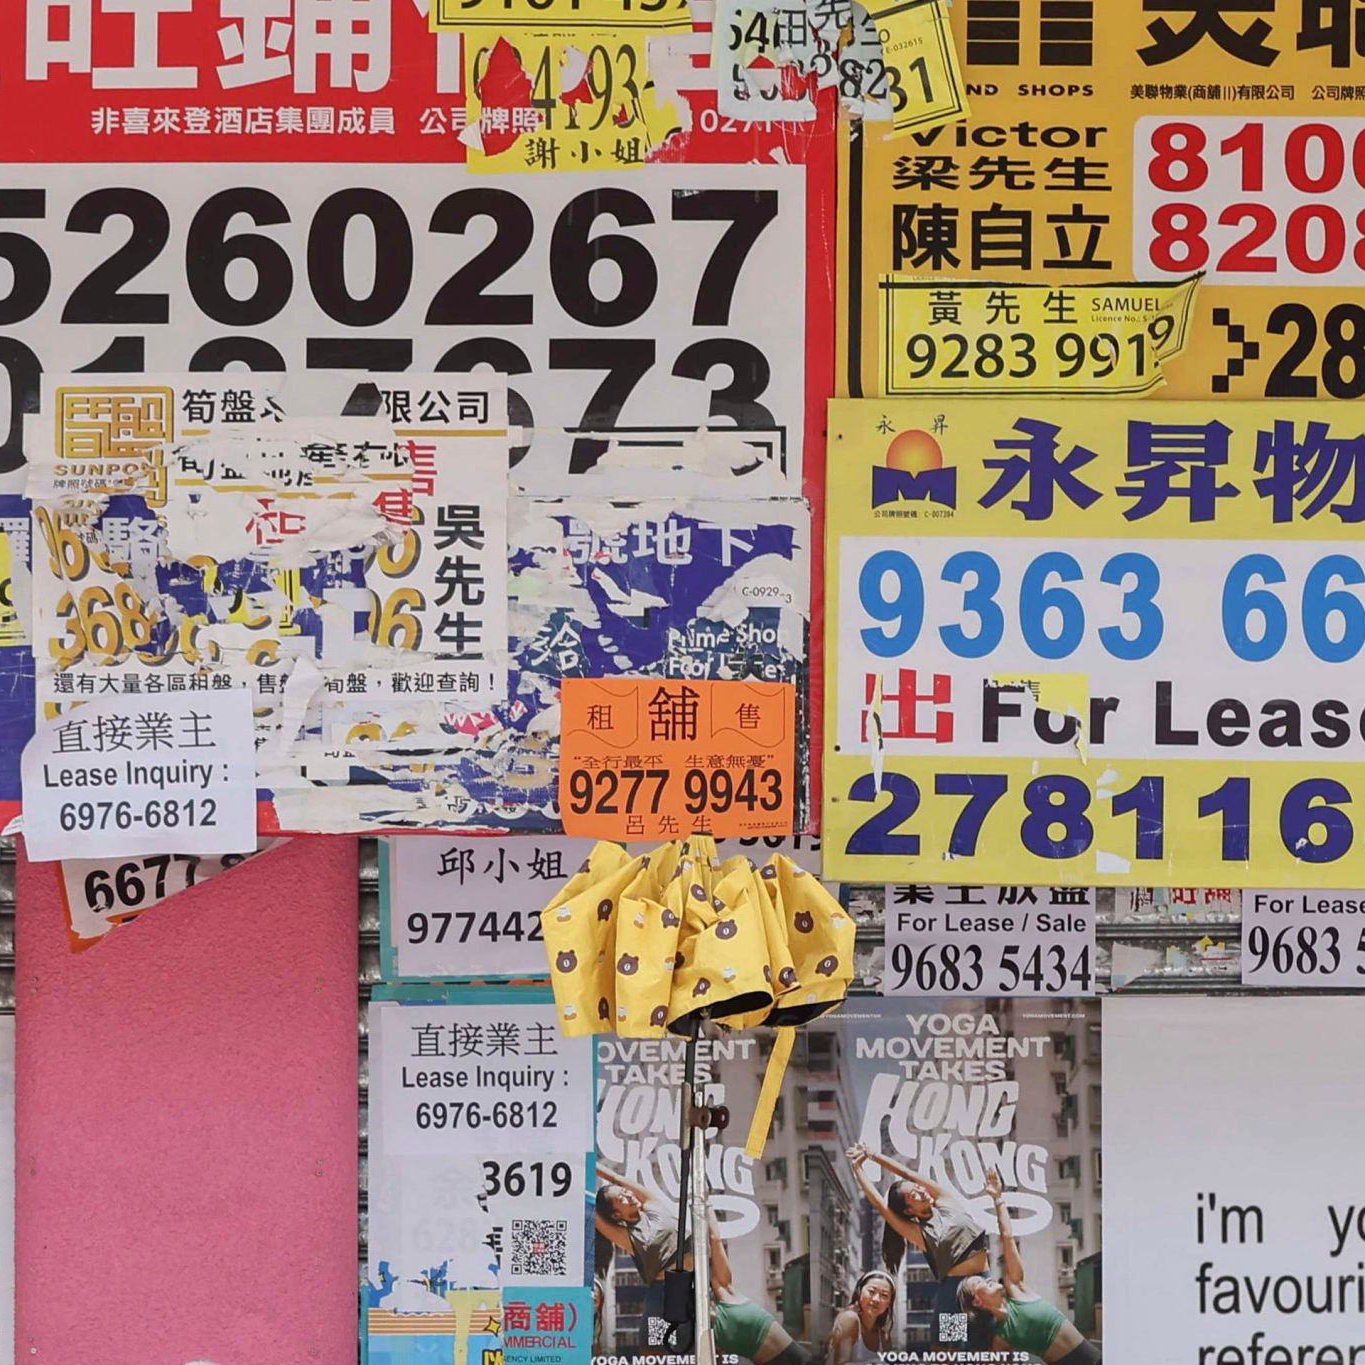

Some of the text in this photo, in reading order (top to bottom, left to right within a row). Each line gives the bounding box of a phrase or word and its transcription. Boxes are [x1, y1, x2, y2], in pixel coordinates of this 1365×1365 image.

[1018, 83, 1094, 97] SHOPS
[91, 106, 395, 137] 非喜來登酒店集團成員
[892, 155, 1113, 192] 梁先生
[892, 203, 1113, 271] 陳自立
[929, 291, 1078, 325] 黃先生
[906, 332, 1037, 379] 9283
[435, 503, 485, 662] 吳先生
[857, 549, 1165, 661] 9363
[982, 679, 1120, 745] For
[53, 710, 217, 754] 直接業主
[44, 760, 212, 792] Lease Inquiry
[570, 770, 783, 814] 9277 9943
[59, 799, 217, 831] 6976-6812
[437, 848, 569, 884] 邱小姐
[1254, 895, 1295, 914] For
[1248, 926, 1341, 974] 9683
[907, 1014, 1000, 1035] YOGA
[856, 1037, 1051, 1059] MOVEMENT
[899, 1061, 1006, 1082] TAKES
[860, 1072, 1020, 1183] HONG
[483, 1161, 572, 1197] 3619
[918, 1133, 1054, 1236] KONG
[1195, 1193, 1265, 1243] i'm
[877, 1352, 1029, 1362] YOGA MOVEMENT IS
